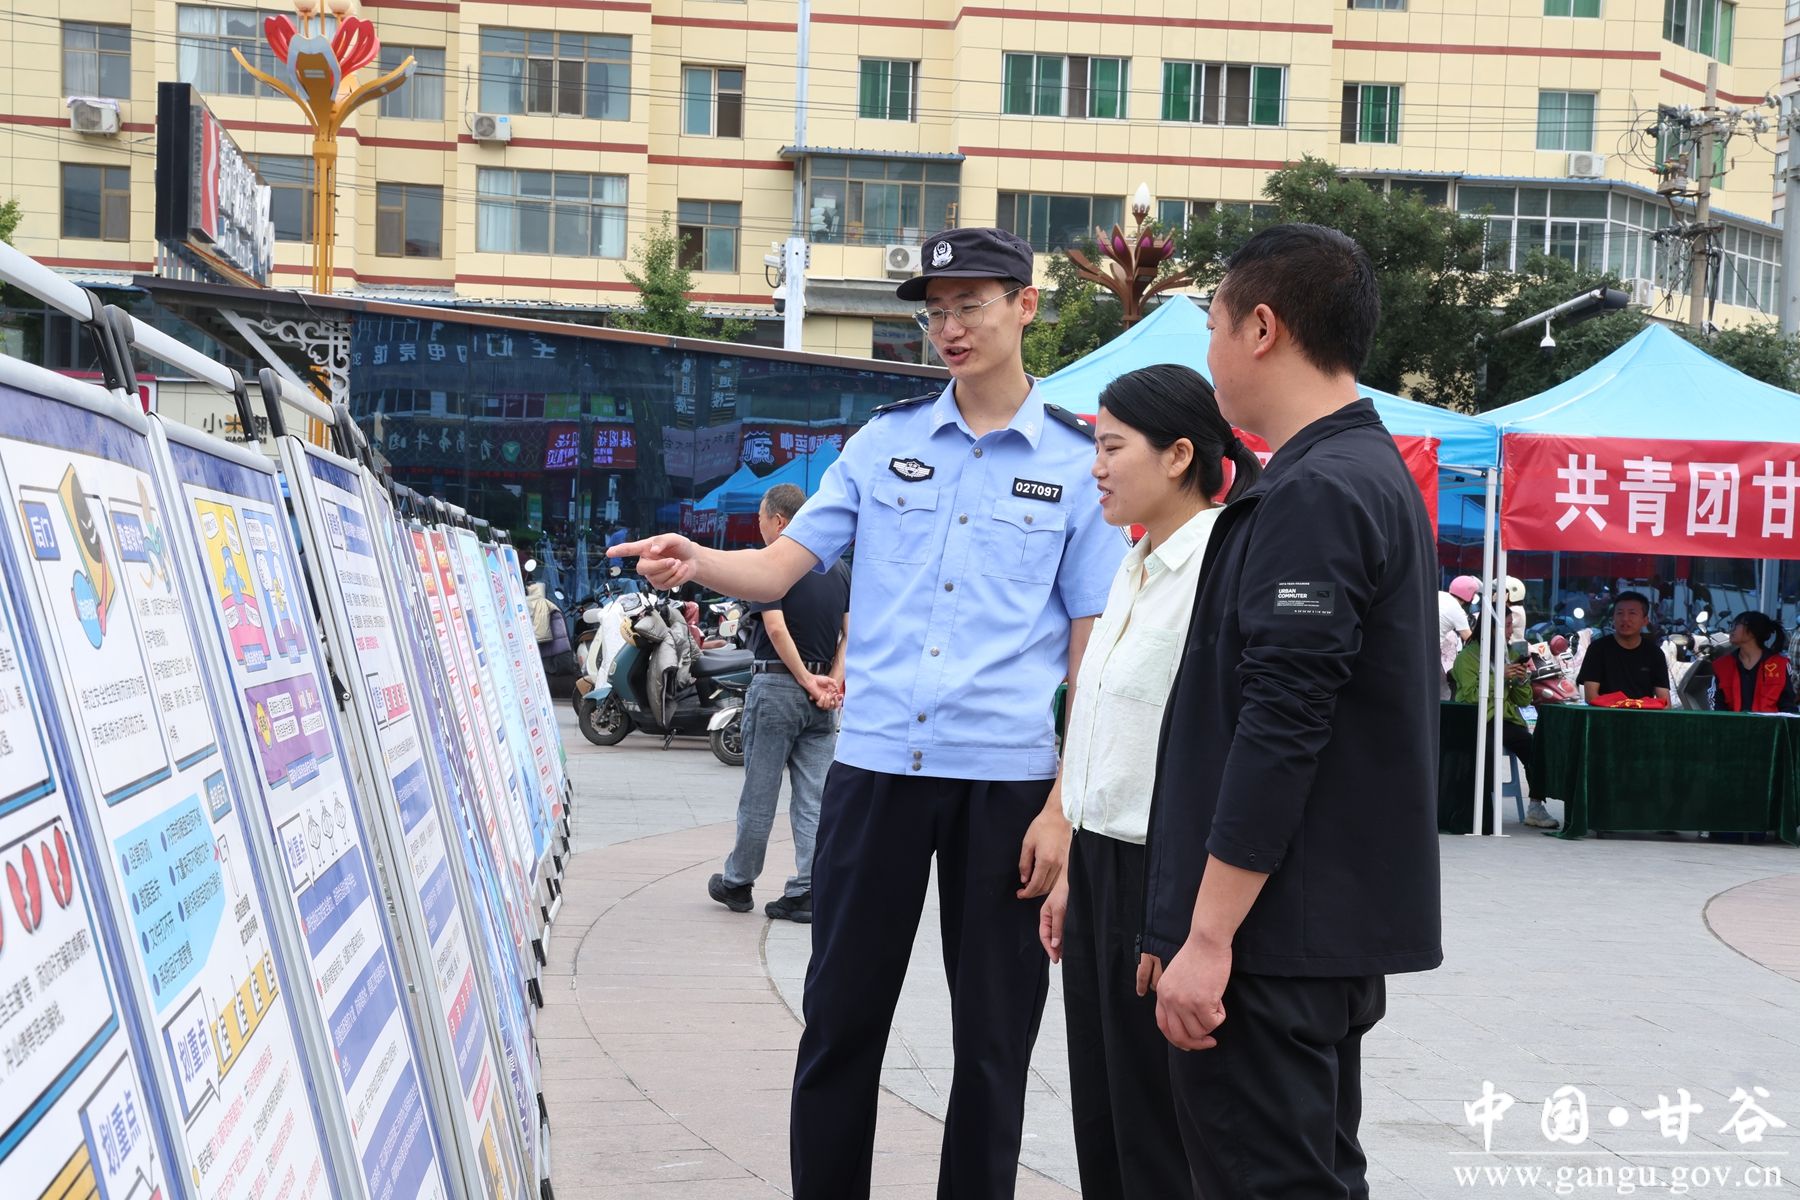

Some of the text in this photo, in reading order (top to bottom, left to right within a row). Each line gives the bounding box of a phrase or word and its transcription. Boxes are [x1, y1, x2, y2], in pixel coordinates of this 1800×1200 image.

[1015, 482, 1060, 499] 027097
[1555, 453, 1800, 539] 共青团甘
[31, 516, 55, 548] 后门
[139, 879, 163, 912] 数据丢失
[149, 910, 177, 948] 文件打不开
[178, 1018, 211, 1083] 划重点
[98, 1089, 141, 1176] 划重点
